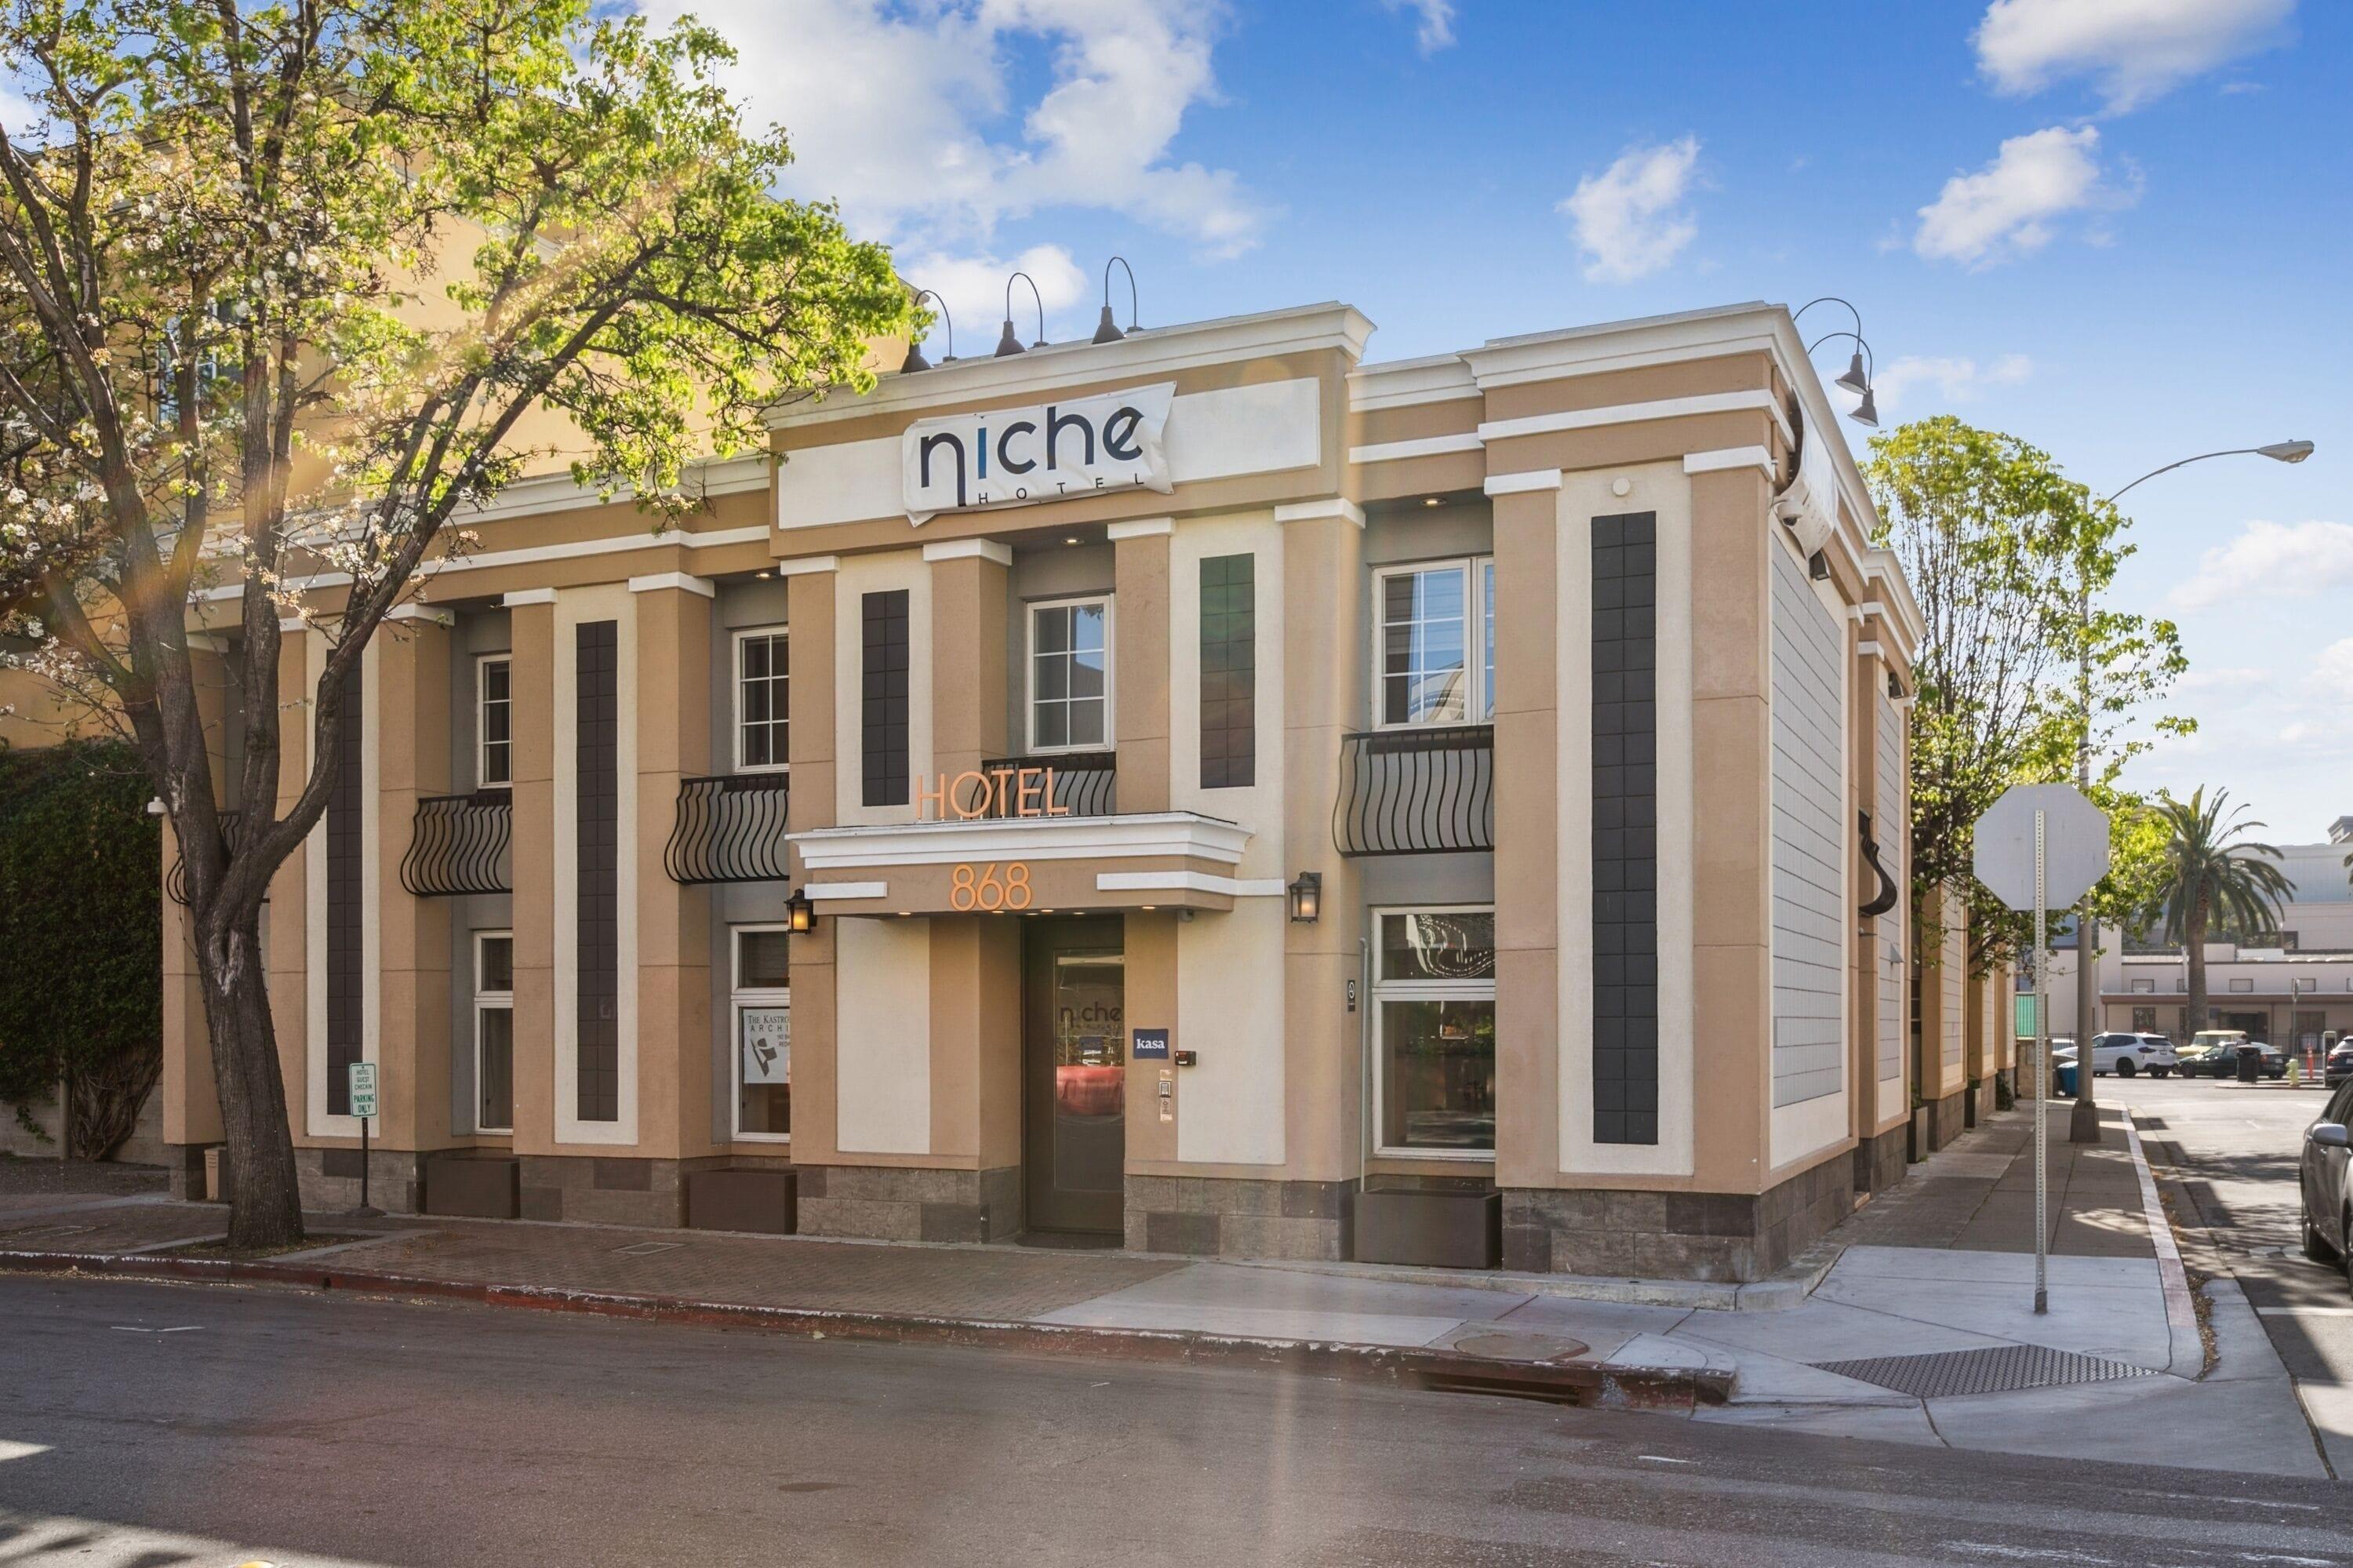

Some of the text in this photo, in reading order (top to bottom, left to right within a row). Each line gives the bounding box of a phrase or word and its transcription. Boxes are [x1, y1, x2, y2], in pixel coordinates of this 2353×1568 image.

[920, 406, 1144, 508] niche
[978, 472, 1145, 505] HOTEL
[916, 766, 1069, 820] HOTEL
[949, 861, 1032, 911] 868
[747, 1015, 760, 1024] THE
[1060, 1001, 1122, 1029] nche
[1136, 1038, 1166, 1050] kasa
[353, 1093, 375, 1104] PARKING
[358, 1104, 371, 1113] ONLY
